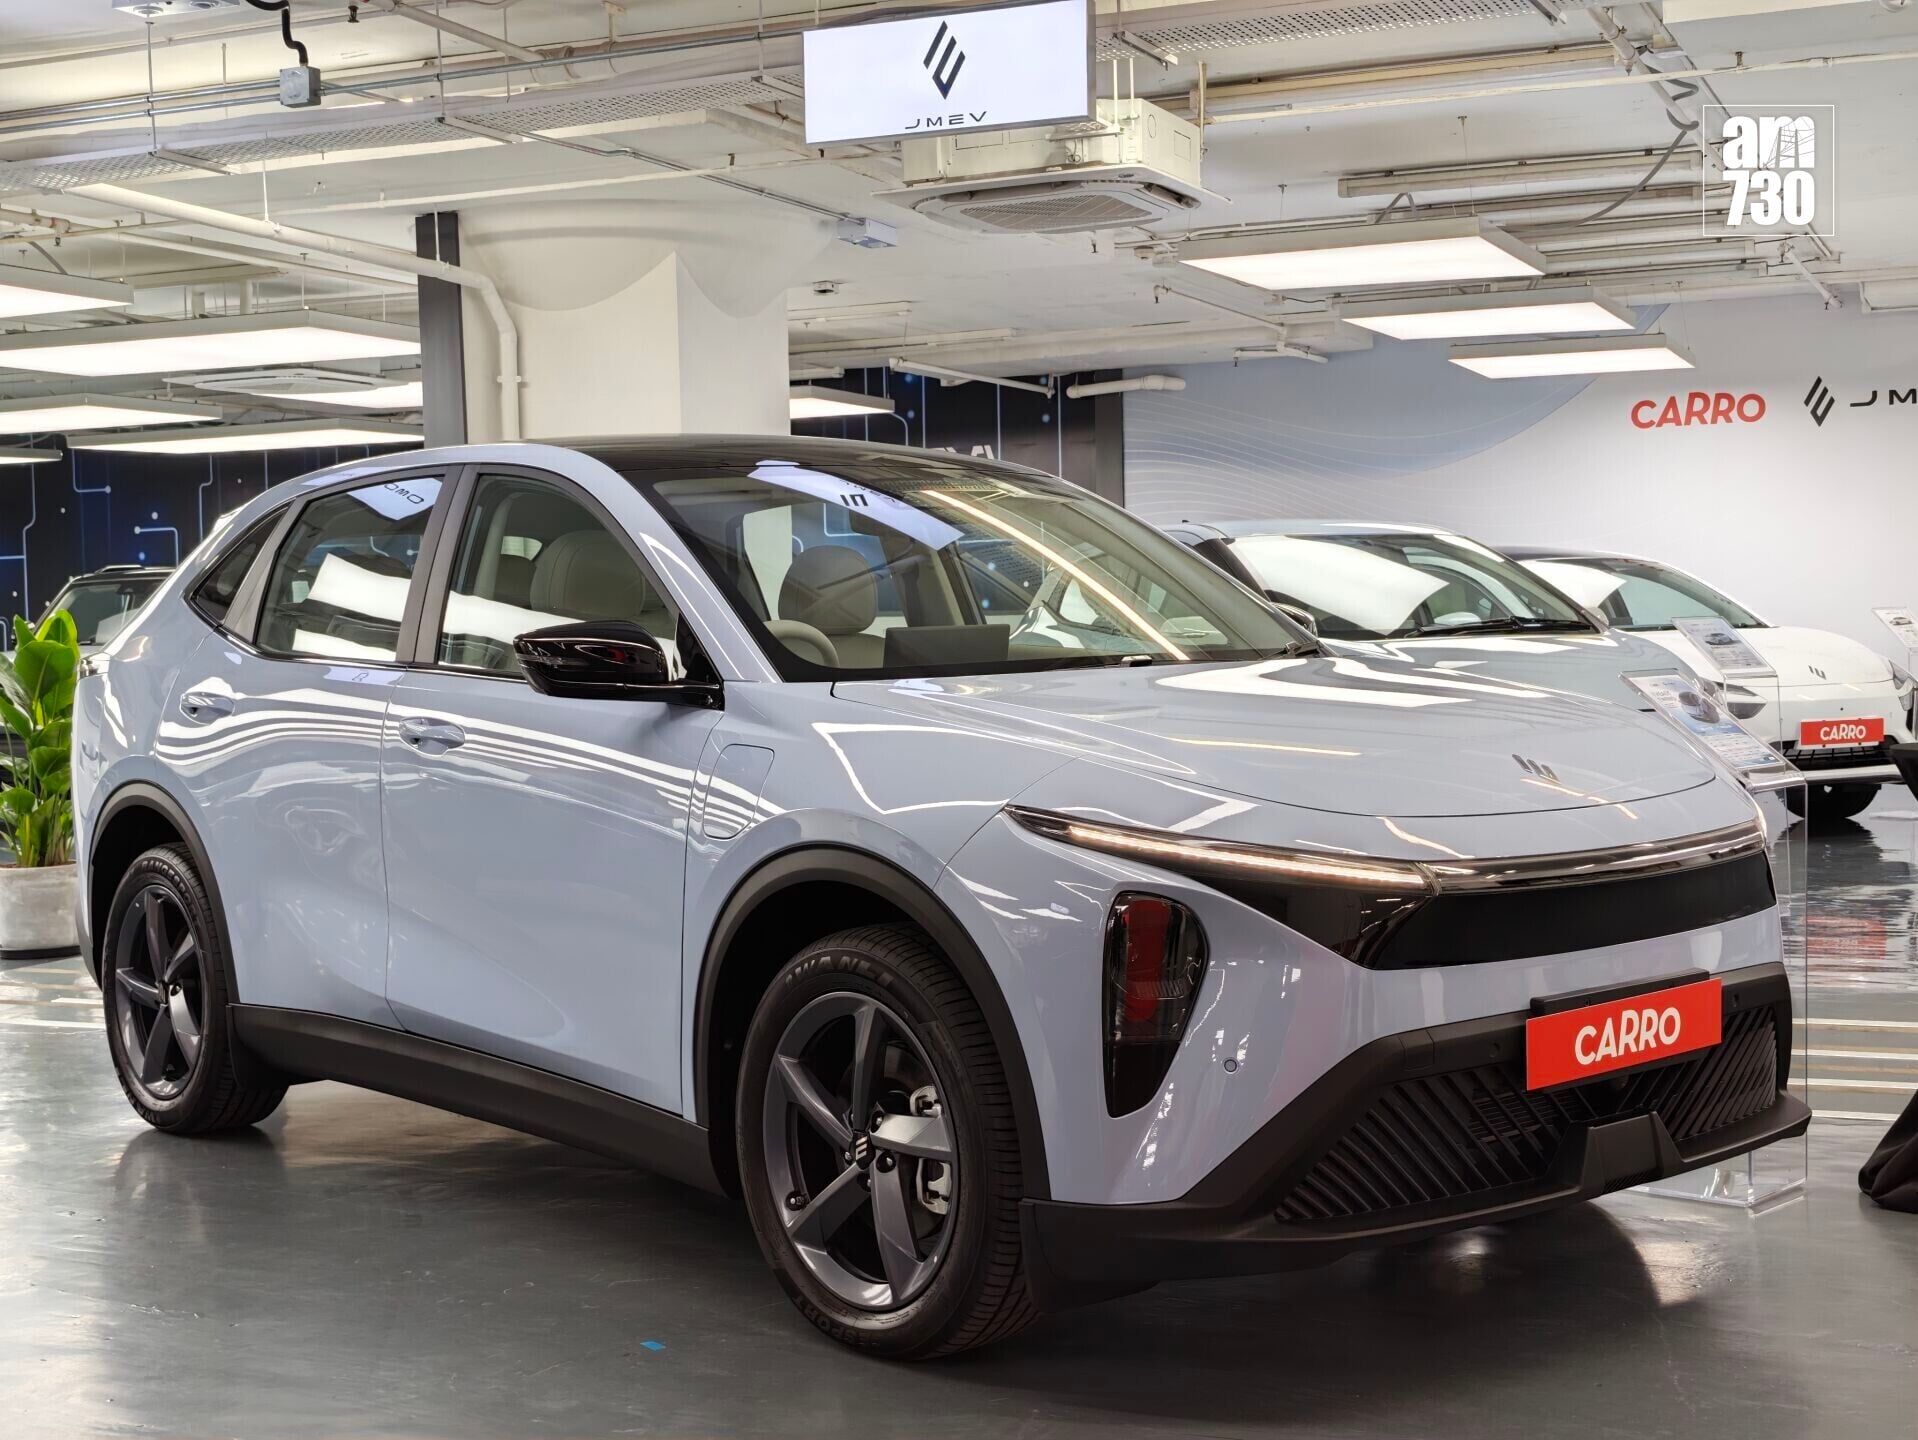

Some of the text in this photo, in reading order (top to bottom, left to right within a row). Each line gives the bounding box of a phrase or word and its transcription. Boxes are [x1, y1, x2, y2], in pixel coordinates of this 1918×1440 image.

[905, 111, 987, 130] JMEV
[1630, 392, 1766, 429] CARRO
[1820, 723, 1867, 741] CARRO
[1575, 1007, 1681, 1066] CARRO
